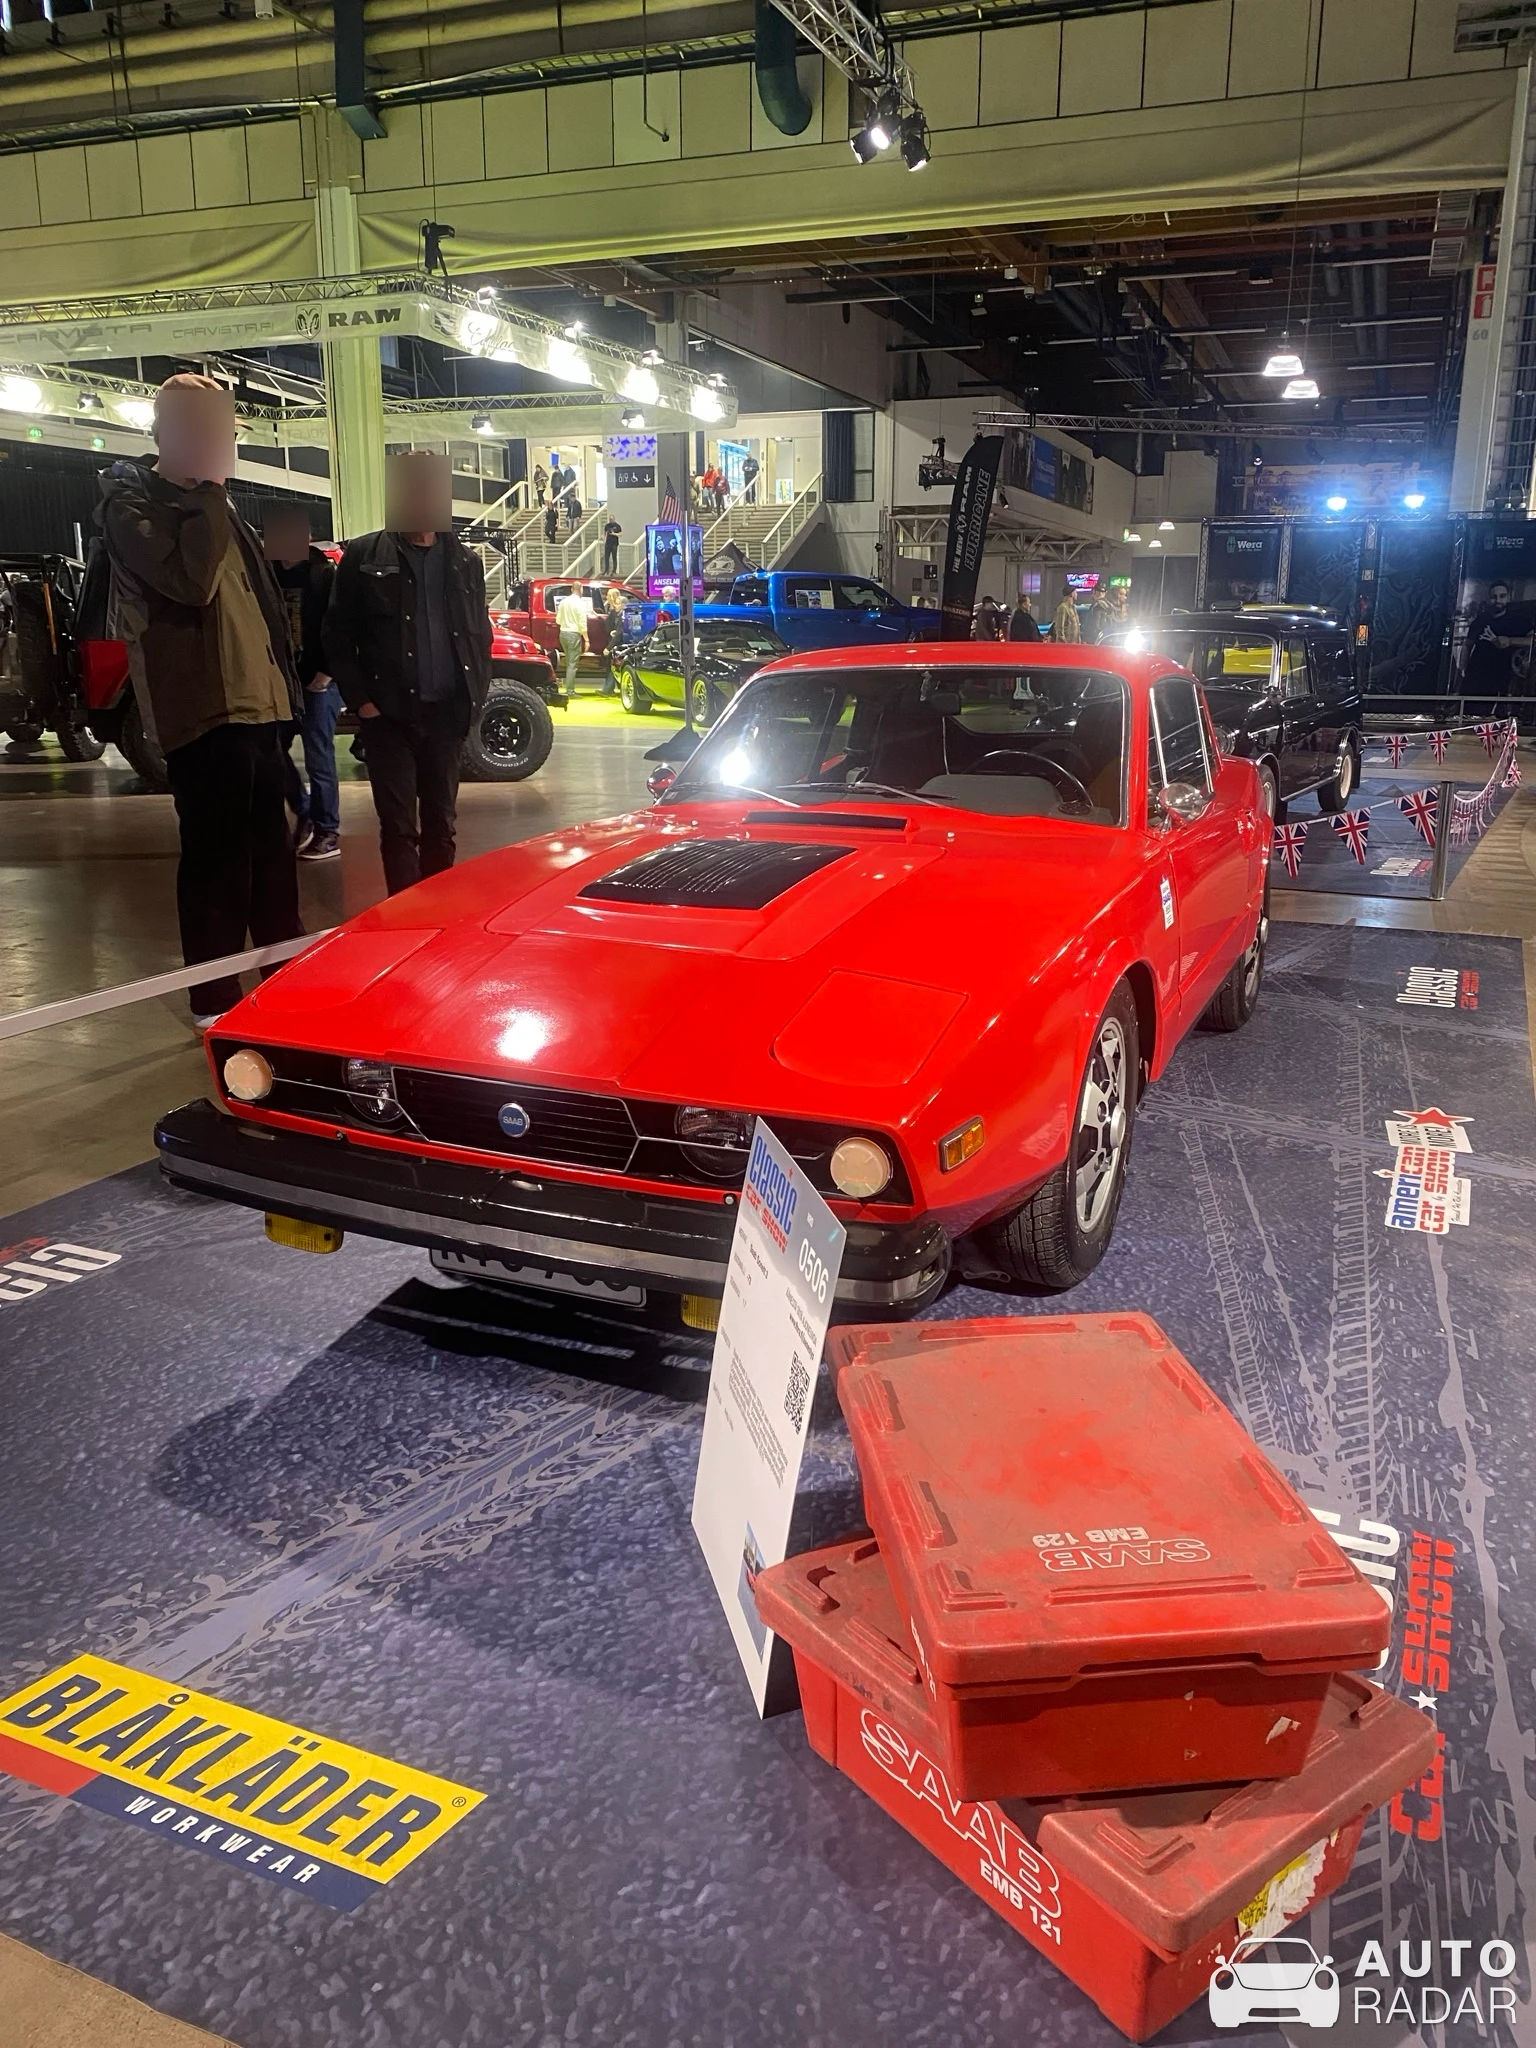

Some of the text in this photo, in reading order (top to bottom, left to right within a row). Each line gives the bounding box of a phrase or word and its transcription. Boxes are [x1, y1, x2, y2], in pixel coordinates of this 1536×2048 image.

[328, 307, 402, 328] RAM
[1473, 328, 1489, 340] 60
[952, 466, 973, 573] THE NEW RAM
[964, 468, 991, 571] HURRICANE
[1237, 540, 1263, 549] Wera
[1496, 536, 1524, 545] Wera
[1395, 966, 1459, 1008] Classic
[502, 1115, 524, 1126] SAAB
[749, 1135, 798, 1236] Classic
[1391, 1146, 1426, 1229] american
[799, 1237, 829, 1304] 0506
[1032, 1526, 1150, 1548] EMB 129
[1038, 1538, 1211, 1573] SAAB
[3, 1673, 442, 1868] BLÅKLÄDER
[124, 1795, 321, 1885] WORKWEAR
[860, 1708, 1062, 1918] SAAB
[980, 1858, 1062, 1946] EMB 121
